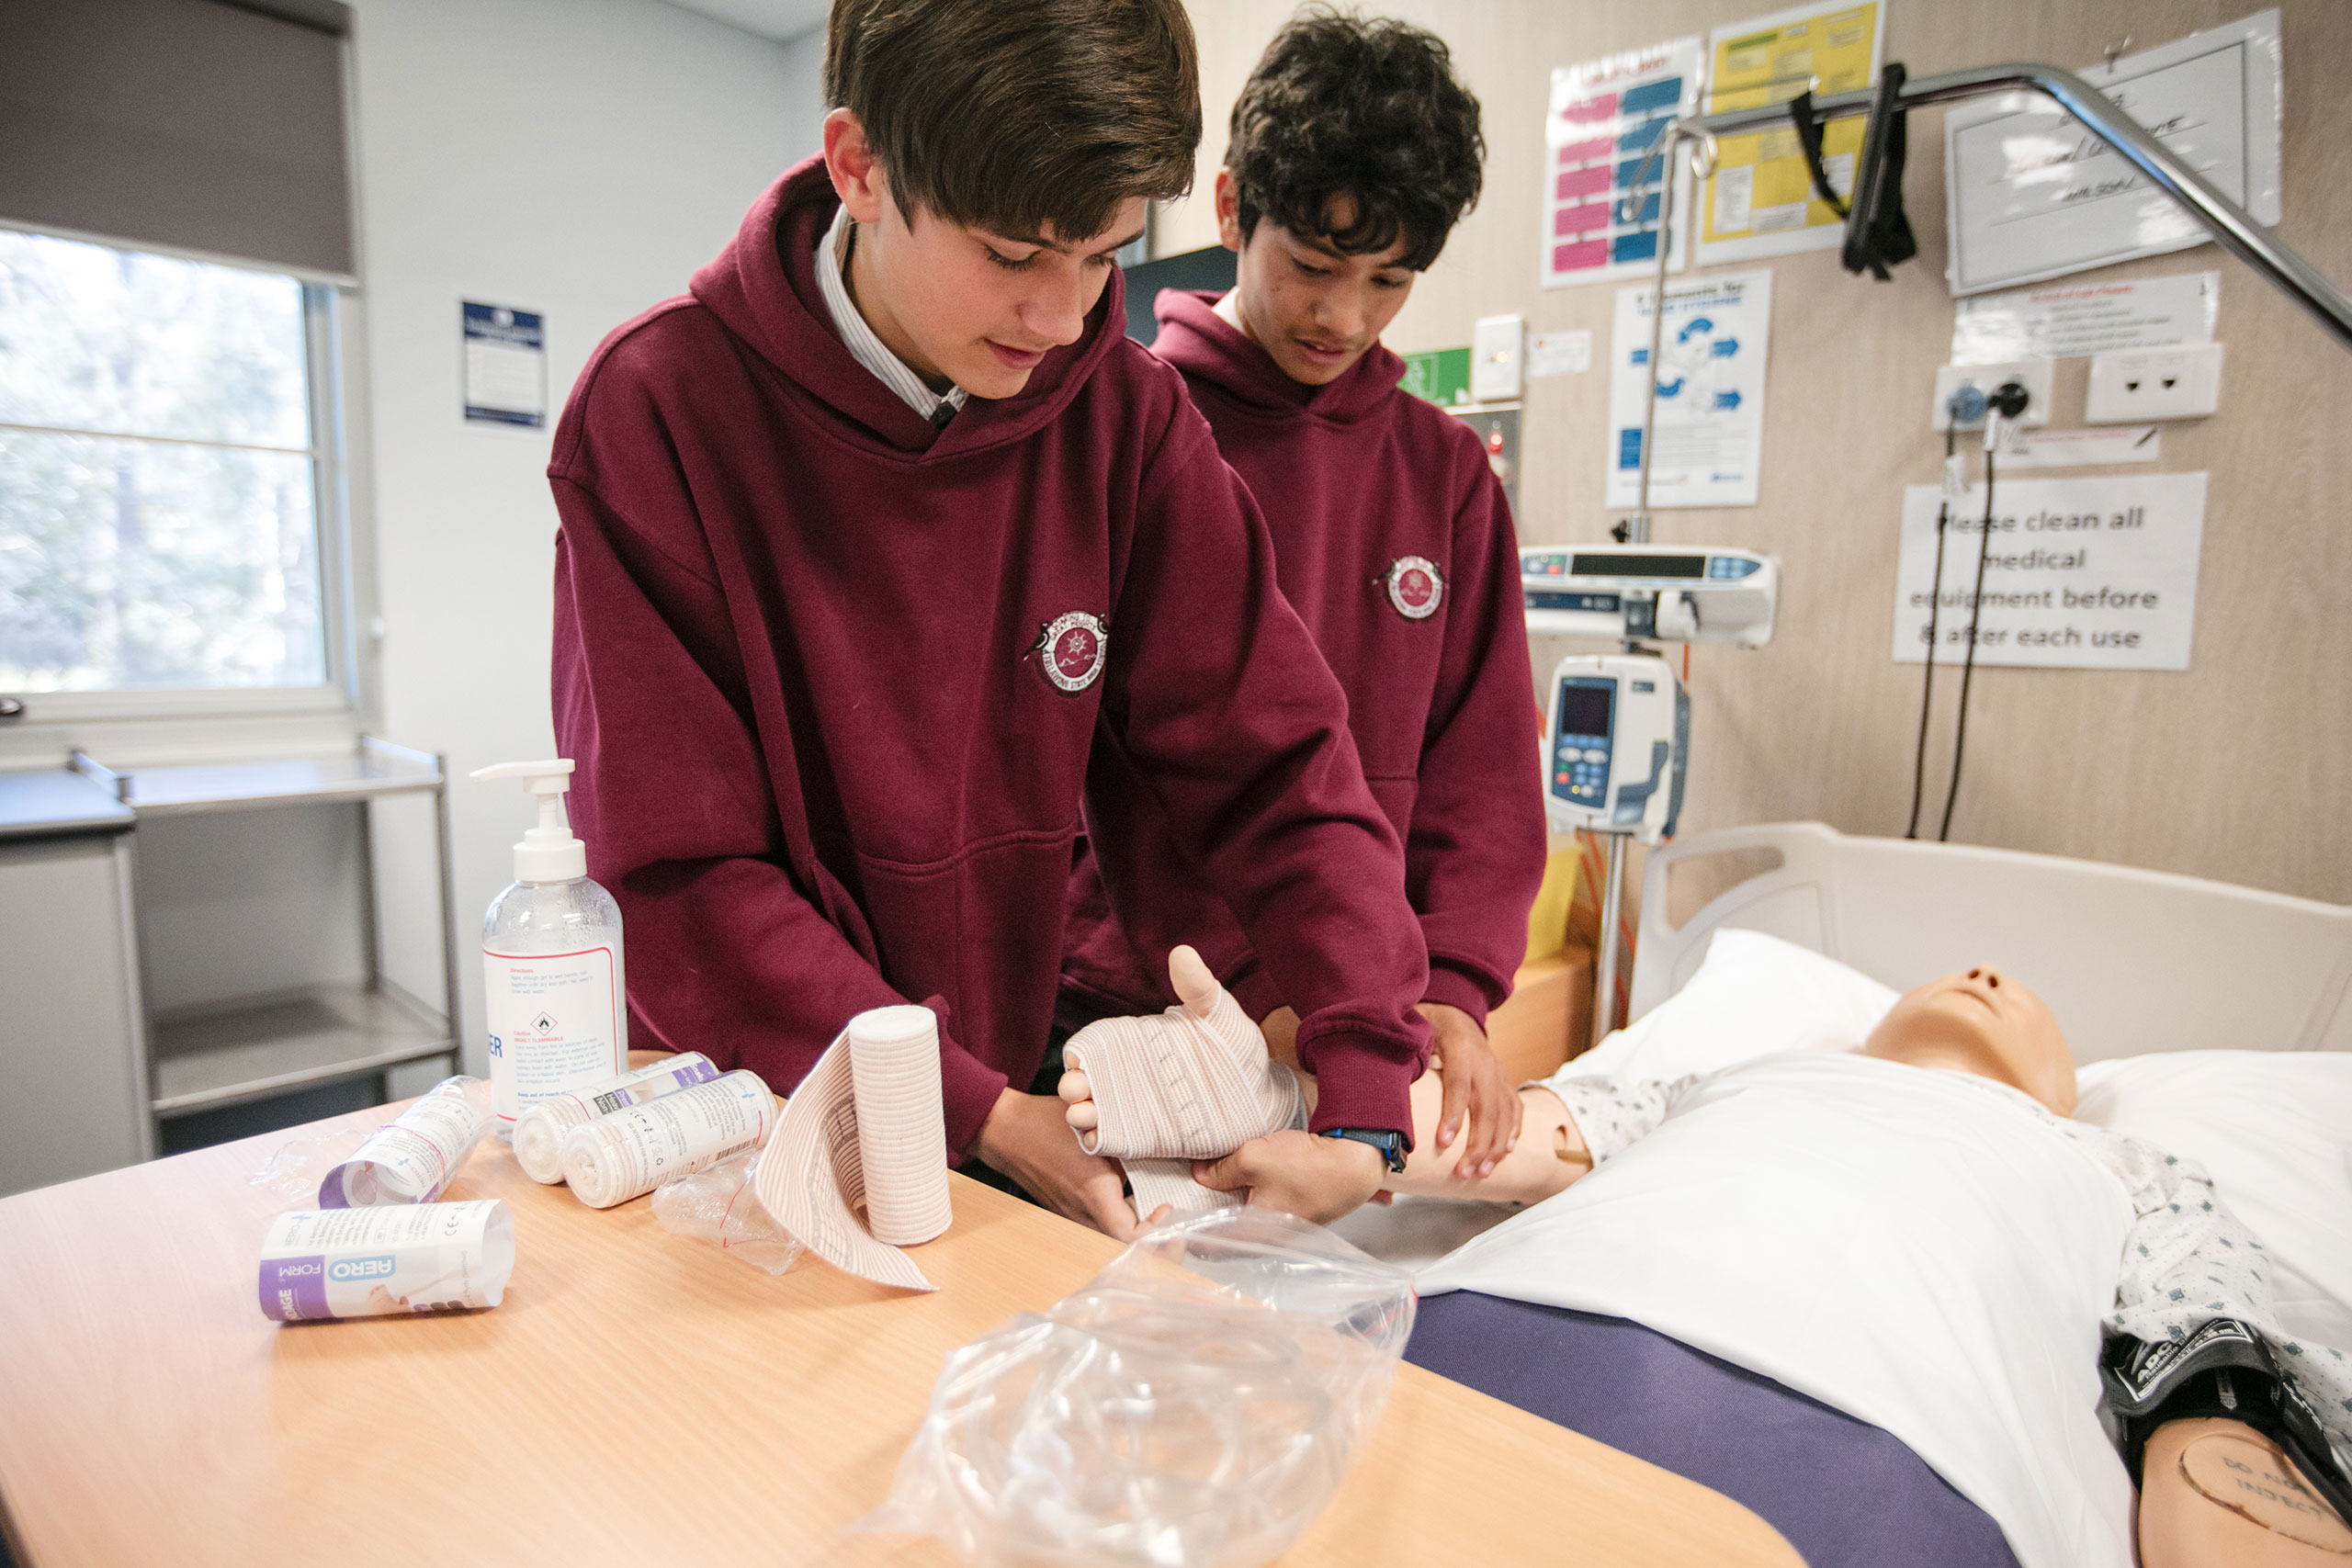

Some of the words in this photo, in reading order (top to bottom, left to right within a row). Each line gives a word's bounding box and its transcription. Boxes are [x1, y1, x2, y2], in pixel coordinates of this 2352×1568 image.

[2026, 511, 2099, 532] clean
[2109, 507, 2145, 529] all
[2063, 587, 2159, 610] before
[2016, 626, 2081, 647] each
[2091, 630, 2142, 649] use
[279, 1263, 321, 1277] FORM
[334, 1258, 392, 1277] AERO
[2138, 1342, 2173, 1382] ADC
[2222, 1457, 2254, 1473] DO
[2236, 1477, 2324, 1520] INJECT
